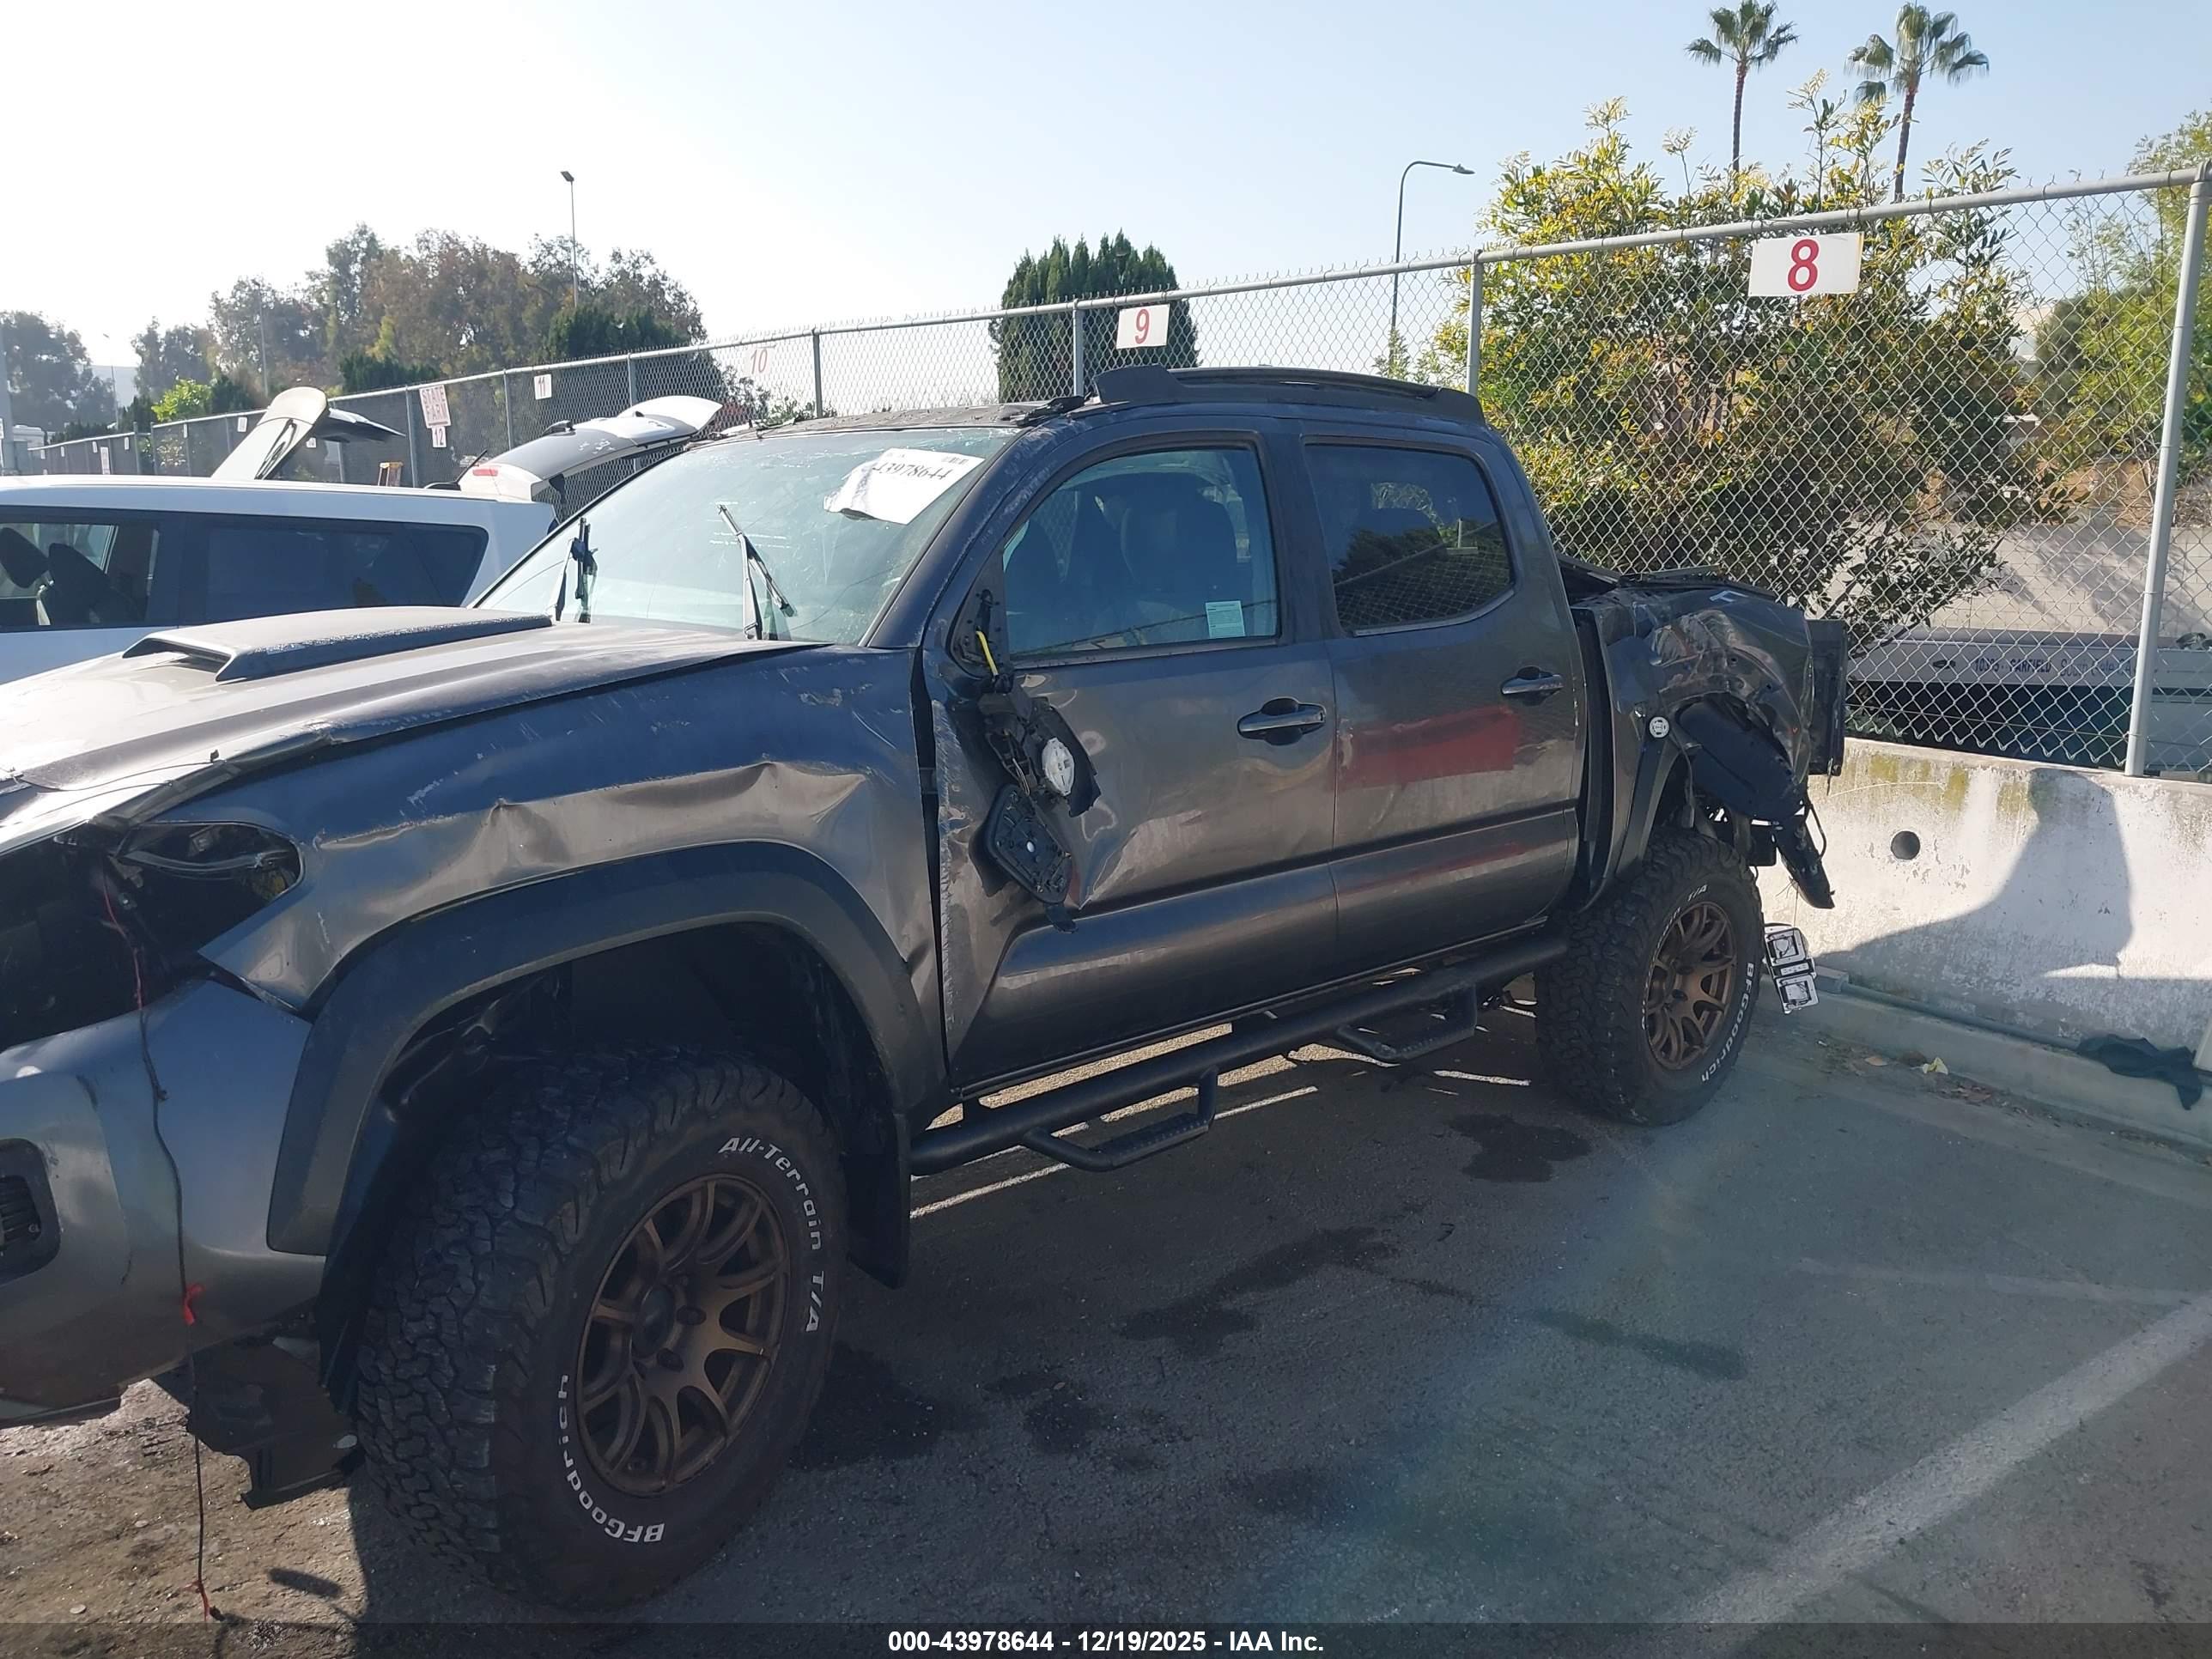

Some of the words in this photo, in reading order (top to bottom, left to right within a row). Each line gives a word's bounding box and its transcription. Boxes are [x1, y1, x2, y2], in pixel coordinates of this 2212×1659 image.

[1787, 238, 1820, 292] 8
[1134, 308, 1150, 344] 9
[750, 348, 768, 374] 10
[421, 386, 446, 404] STATE
[538, 377, 547, 398] 11
[434, 428, 445, 447] 12
[1700, 962, 1755, 1083] BFGoodrich
[718, 1136, 823, 1250] All-Terrain
[805, 1270, 824, 1333] T/A
[557, 1374, 665, 1543] BFGoodrich
